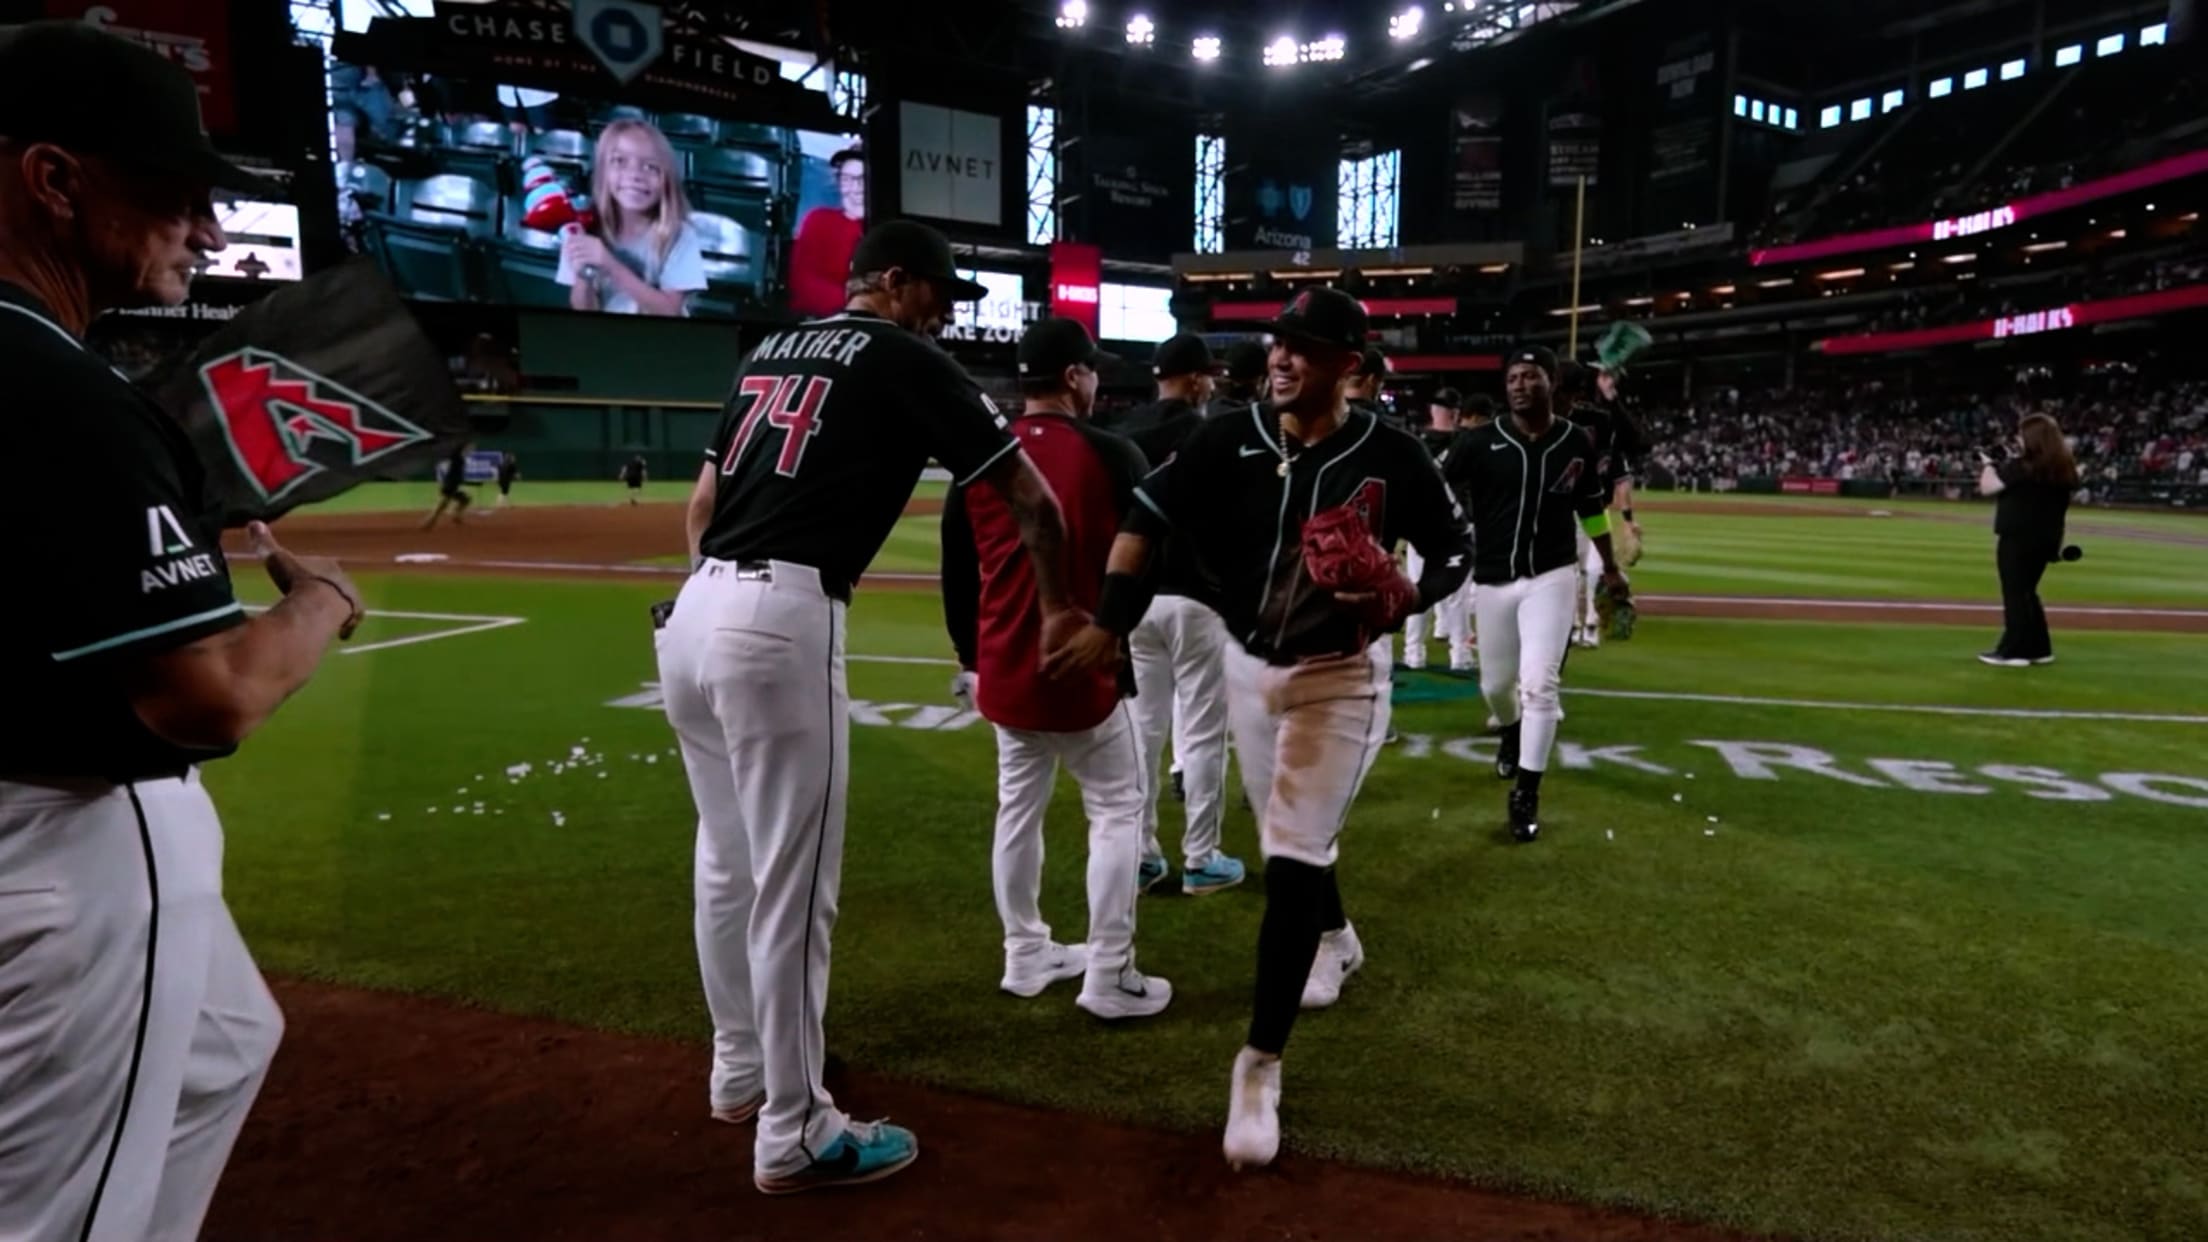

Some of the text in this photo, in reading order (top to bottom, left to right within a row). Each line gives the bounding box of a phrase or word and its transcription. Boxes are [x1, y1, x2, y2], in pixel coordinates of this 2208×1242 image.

[447, 13, 772, 87] CHASE FIELD
[905, 148, 995, 180] AVNET
[1253, 223, 1312, 250] Arizona
[1291, 250, 1312, 267] 42
[752, 328, 873, 367] MATHER
[721, 373, 834, 479] 74
[140, 553, 217, 595] AVNET
